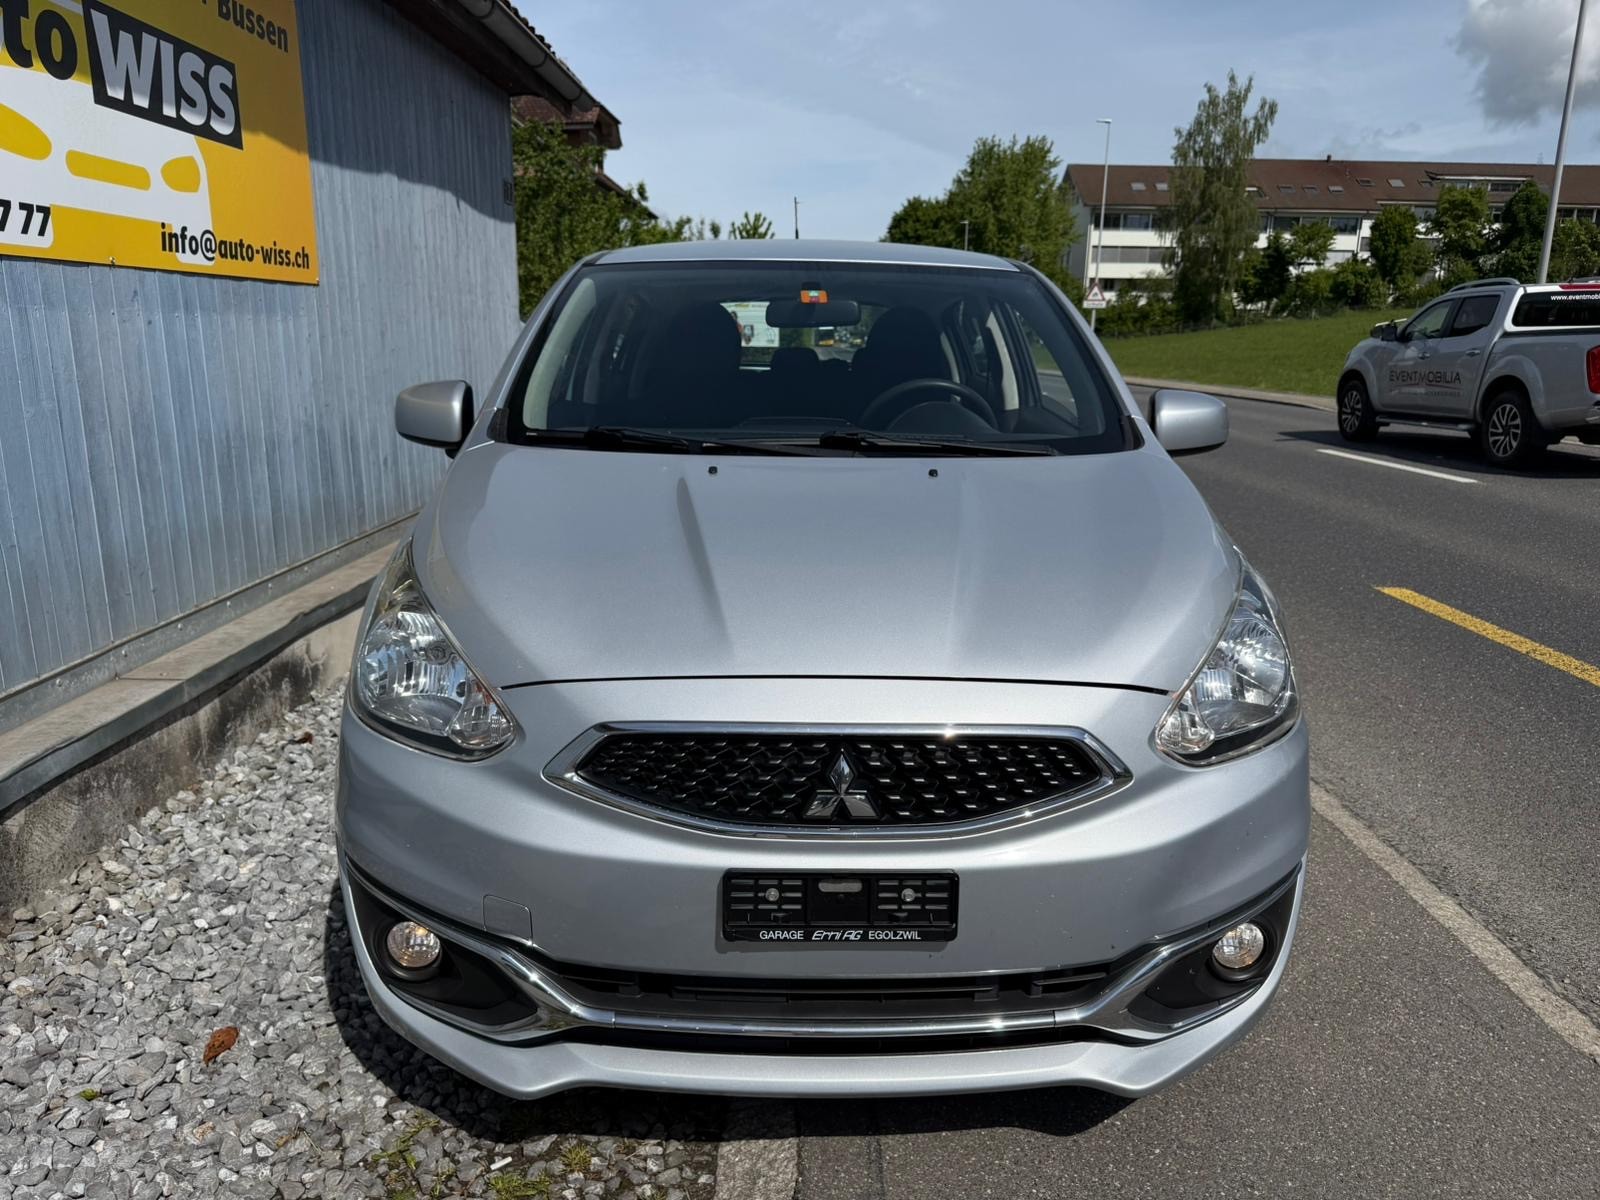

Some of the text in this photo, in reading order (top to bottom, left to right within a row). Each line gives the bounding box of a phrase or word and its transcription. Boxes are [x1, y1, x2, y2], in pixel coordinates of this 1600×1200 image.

[218, 0, 288, 53] Bussen
[90, 8, 236, 136] WISS
[161, 222, 310, 269] info@auto-wiss.ch
[1389, 369, 1462, 384] EVENTMOBILIA
[759, 930, 921, 940] GARAGE Erni AG EGOLZWIL
